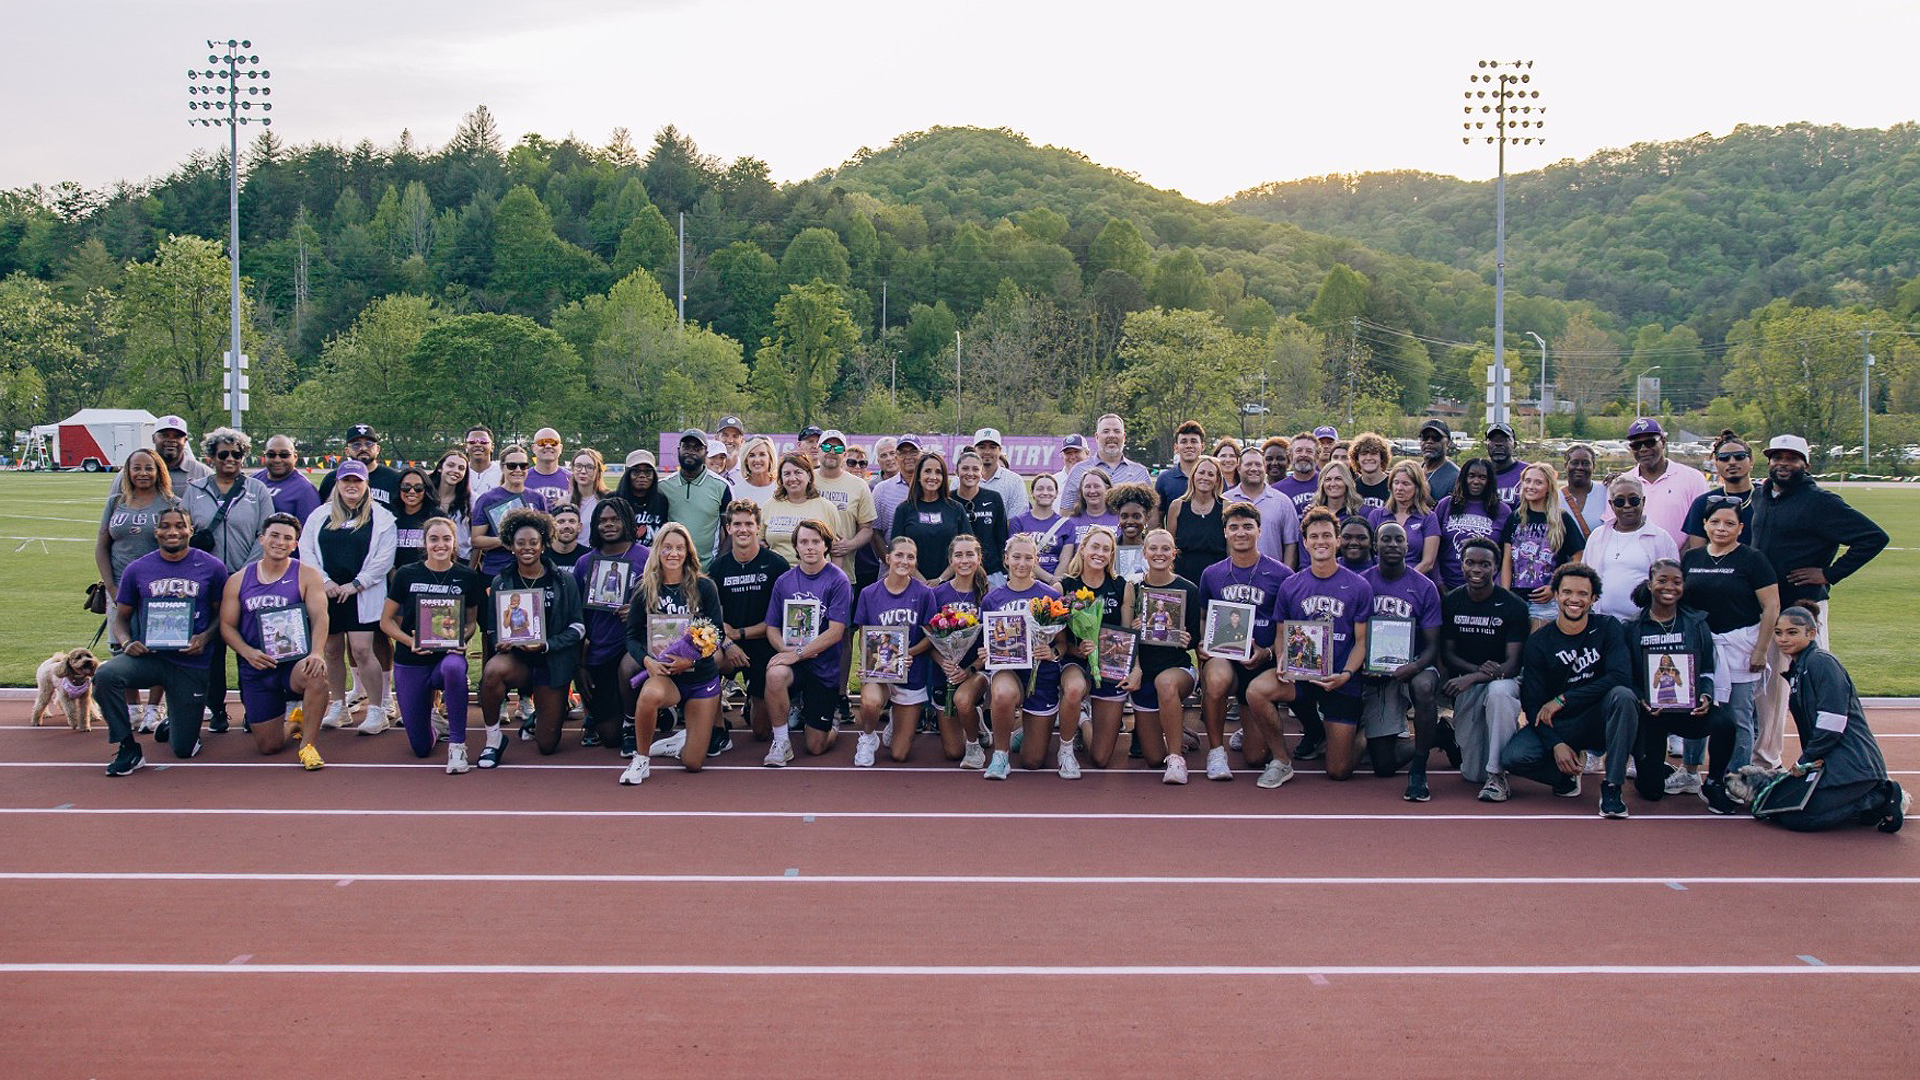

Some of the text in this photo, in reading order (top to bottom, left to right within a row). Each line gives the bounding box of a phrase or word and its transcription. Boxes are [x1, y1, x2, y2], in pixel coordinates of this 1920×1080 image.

[149, 579, 199, 597] WCU
[1221, 585, 1265, 605] WCU
[245, 596, 288, 612] WCU
[1301, 595, 1345, 617] WCU
[879, 609, 918, 626] WCU
[1555, 649, 1577, 665] The
[1572, 647, 1601, 673] Cats
